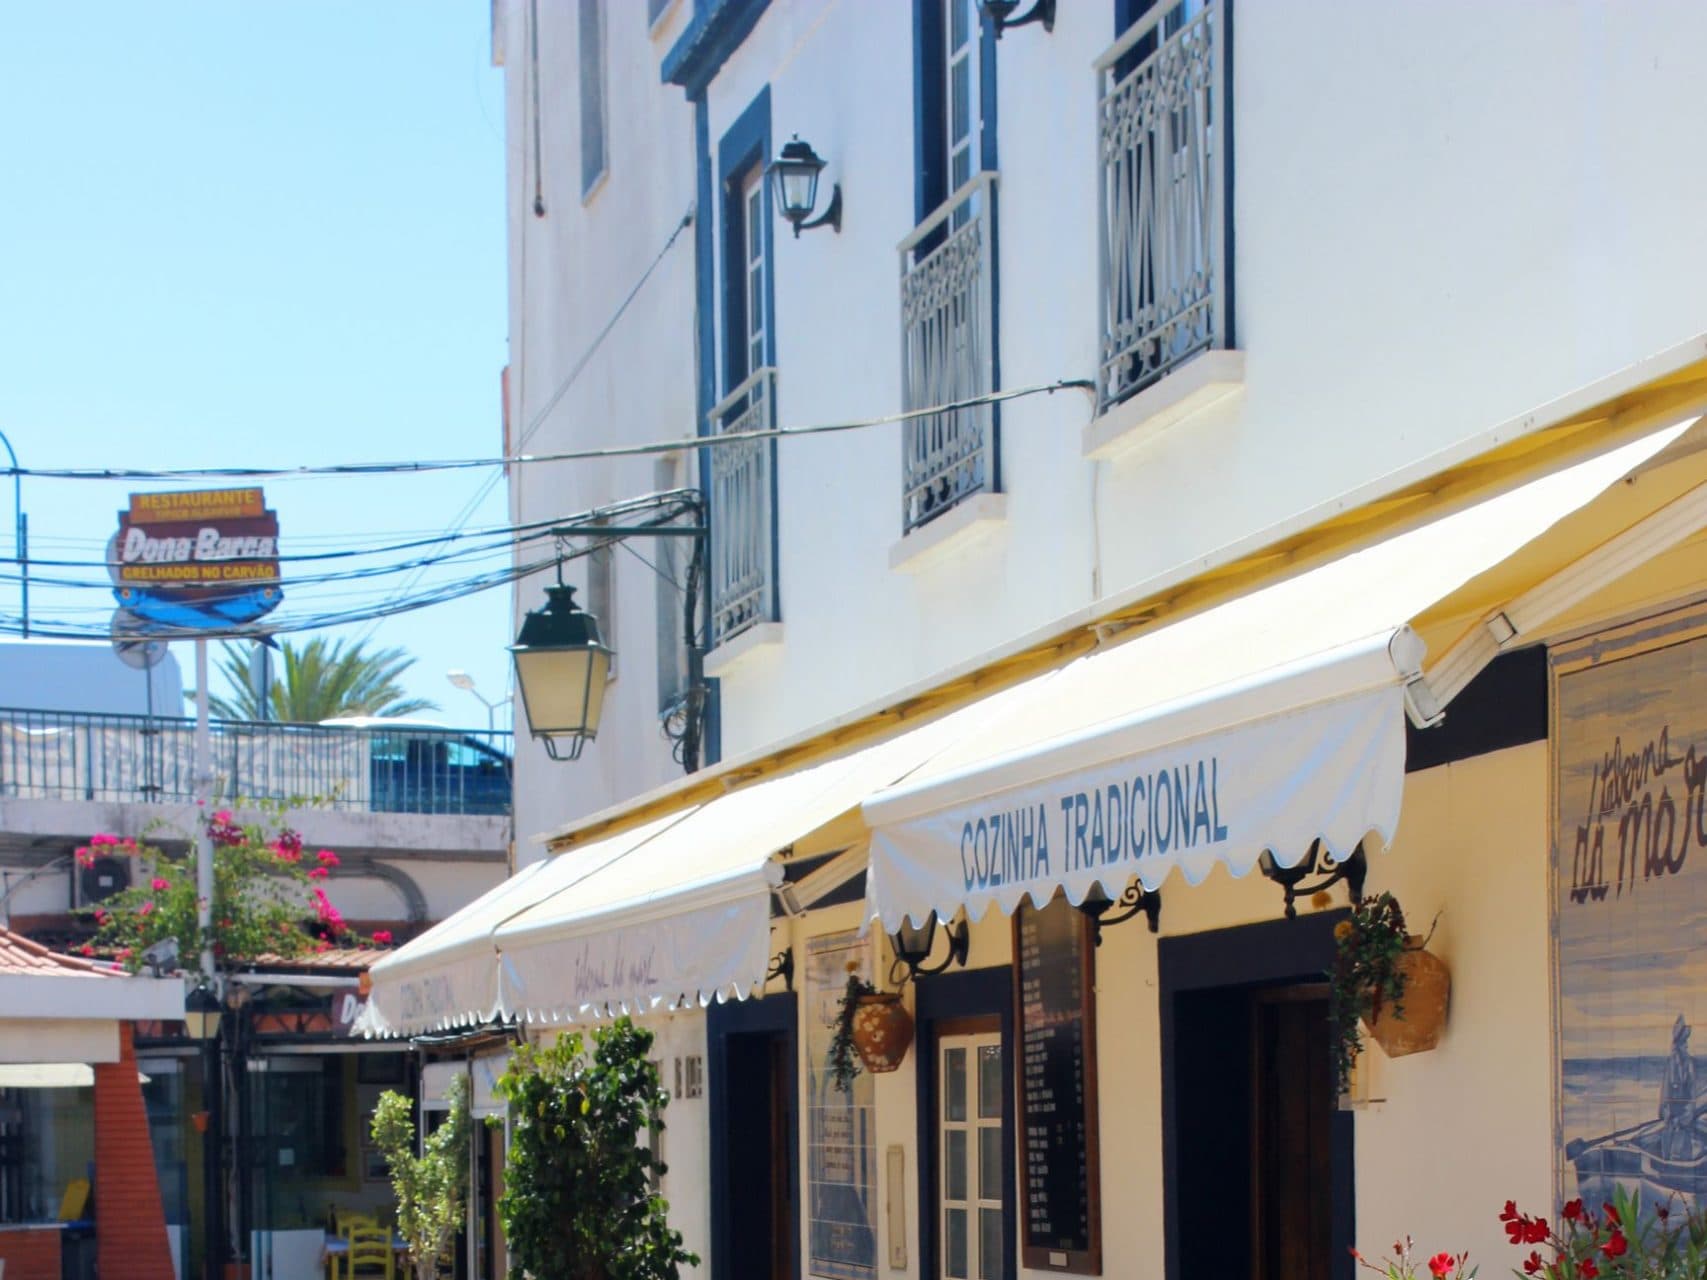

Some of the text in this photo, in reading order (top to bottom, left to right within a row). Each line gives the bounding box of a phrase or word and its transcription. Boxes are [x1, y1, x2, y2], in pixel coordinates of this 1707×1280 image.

[139, 489, 255, 509] RESTAURANTE
[122, 527, 275, 563] Dona Barca
[122, 564, 275, 580] GRELHADOS NO CARVÃO
[960, 757, 1228, 892] COZINHA TRADICIONAL
